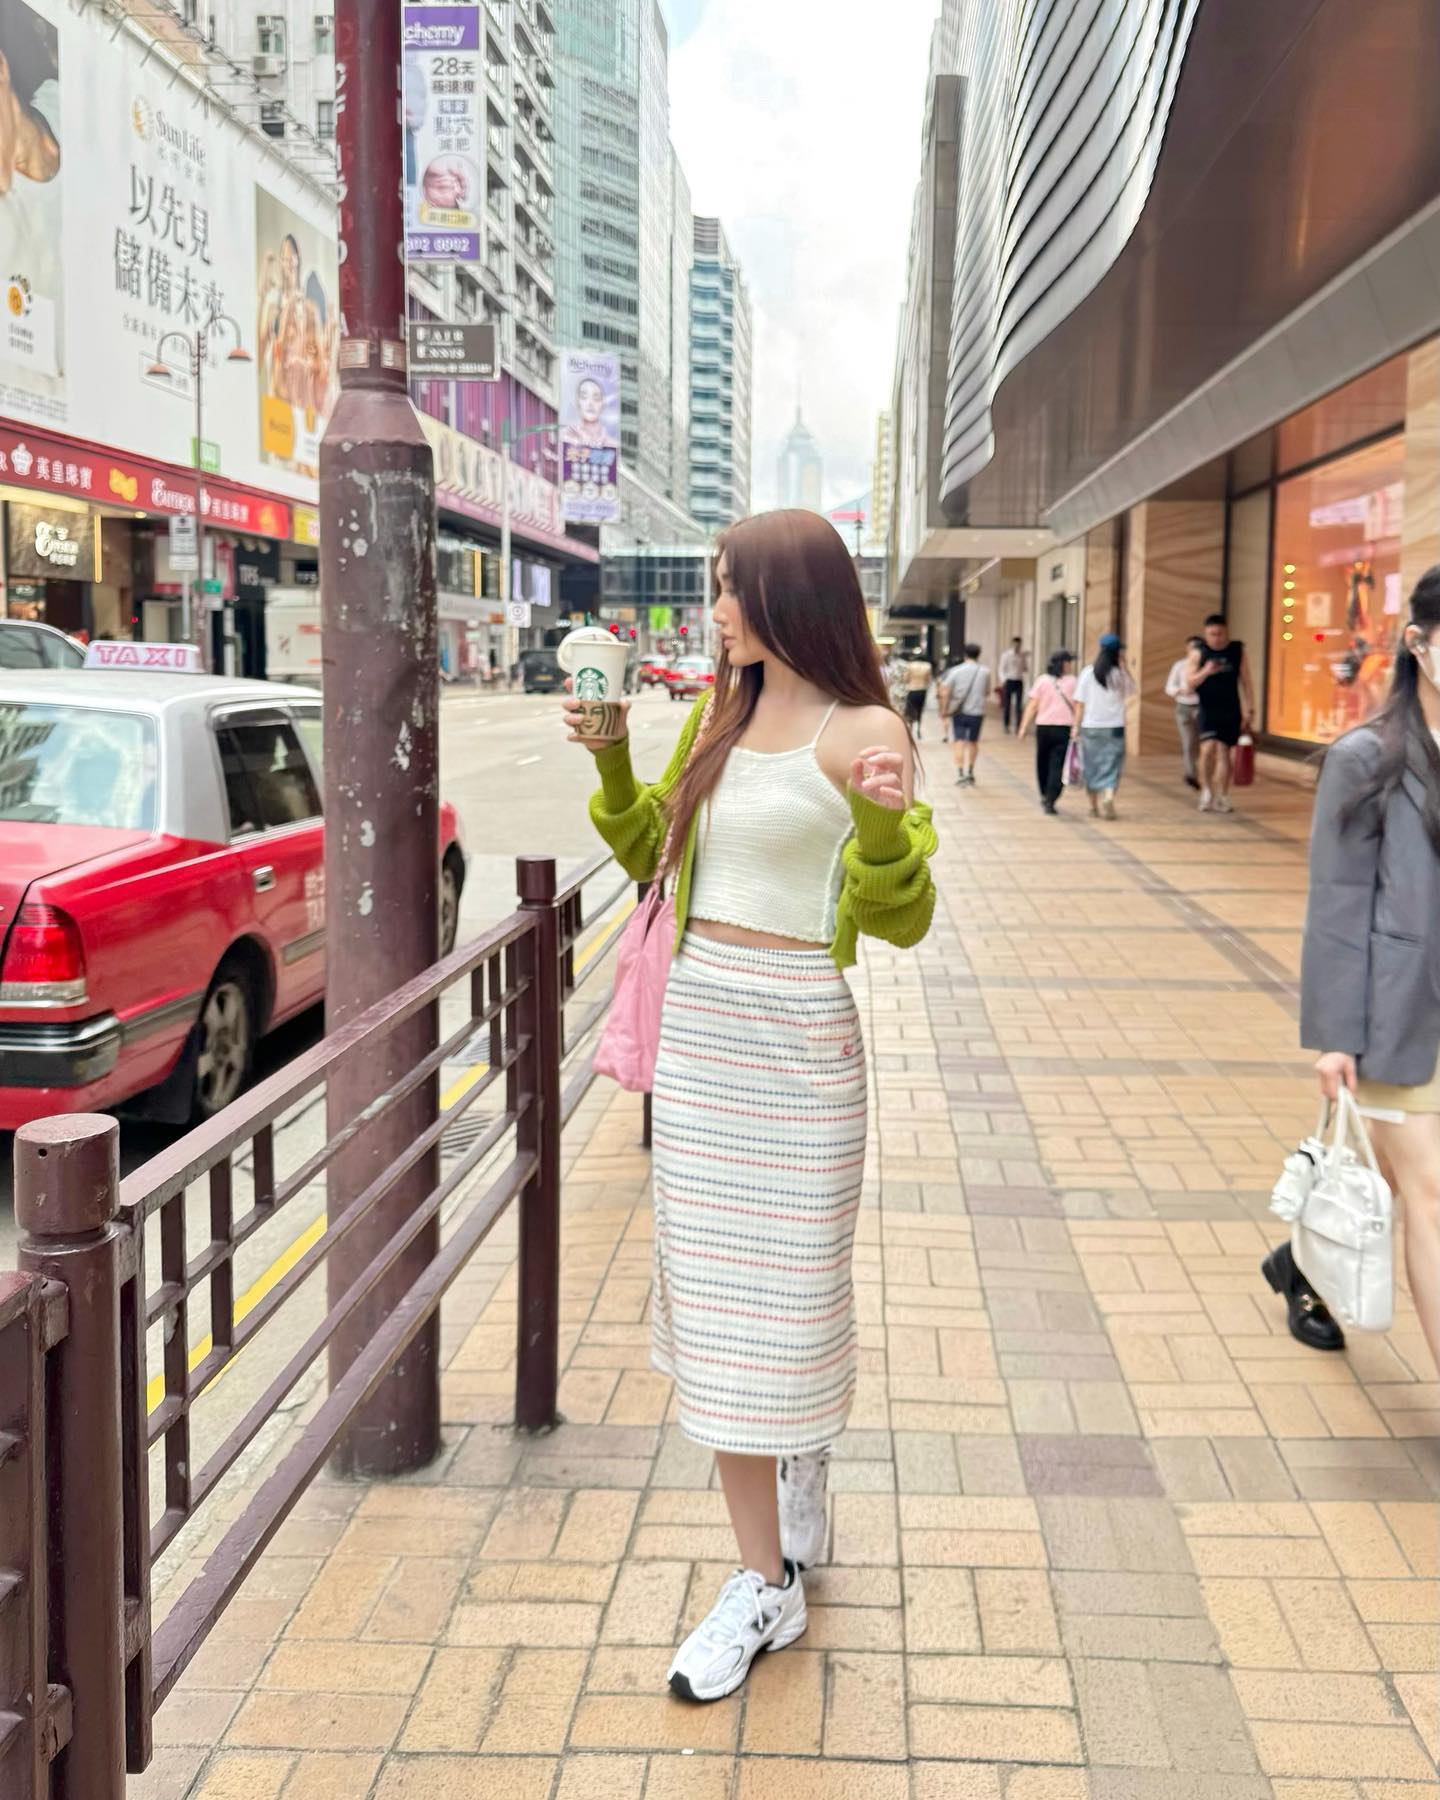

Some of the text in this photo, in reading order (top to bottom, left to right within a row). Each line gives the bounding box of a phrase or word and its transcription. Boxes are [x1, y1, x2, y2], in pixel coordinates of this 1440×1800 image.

[127, 163, 212, 266] 以先見
[95, 644, 187, 668] TAXI
